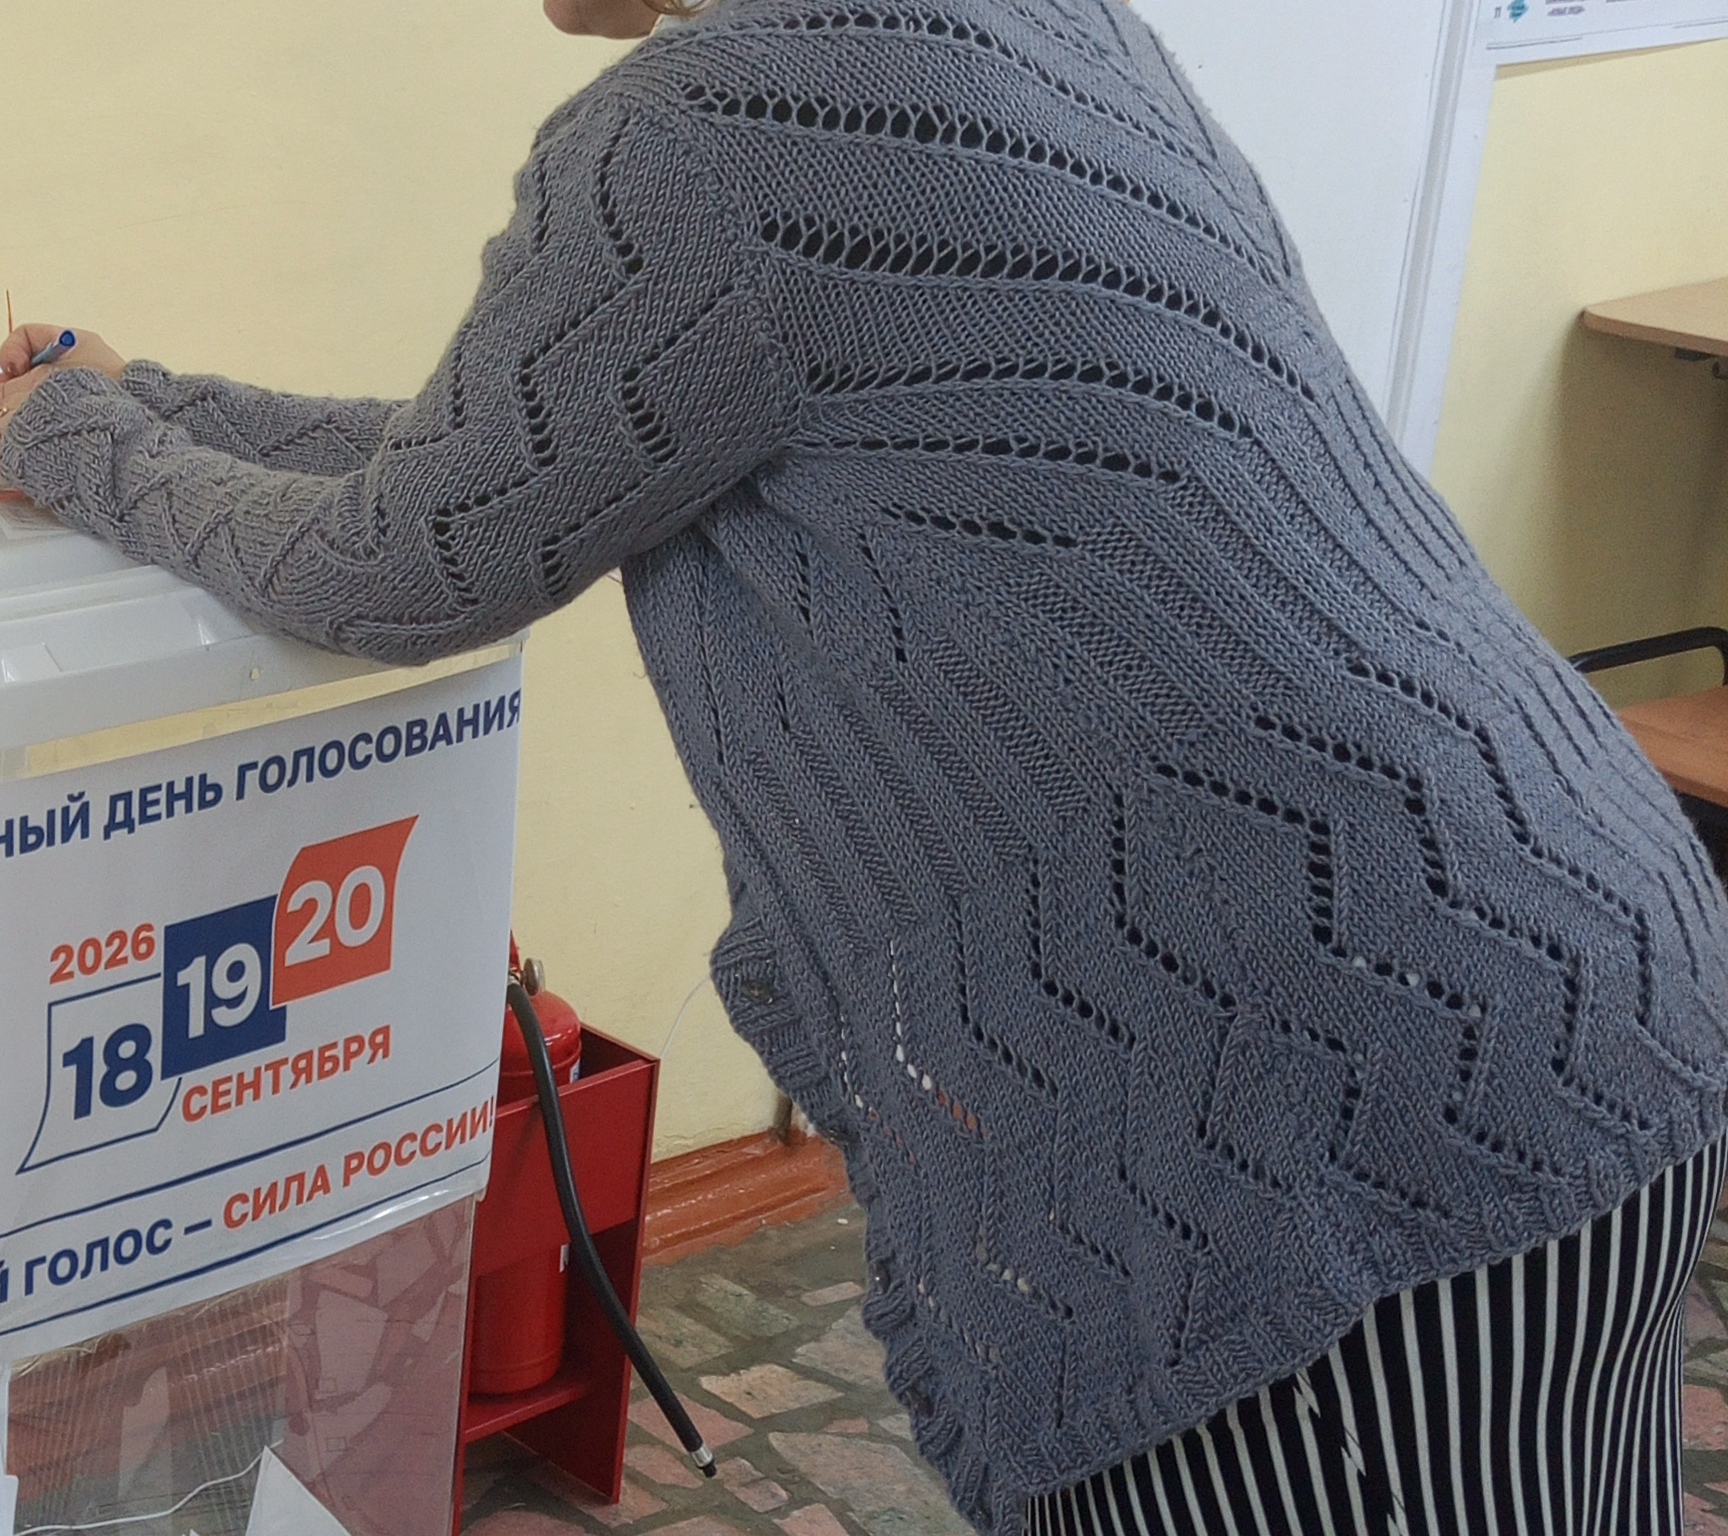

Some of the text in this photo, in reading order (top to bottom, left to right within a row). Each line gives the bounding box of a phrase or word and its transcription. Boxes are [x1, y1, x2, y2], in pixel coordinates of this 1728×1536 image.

[103, 763, 223, 838] ДЕНЬ
[234, 688, 522, 801] ГОЛОСОВАНИЯ
[48, 922, 157, 984] 2026
[61, 864, 387, 1120] 18 19 20
[181, 1024, 393, 1124] СЕНТЯБРЯ
[23, 1217, 174, 1293] ГОЛОС
[222, 1163, 332, 1232] СИЛА
[343, 1093, 496, 1189] РОССИИ!
